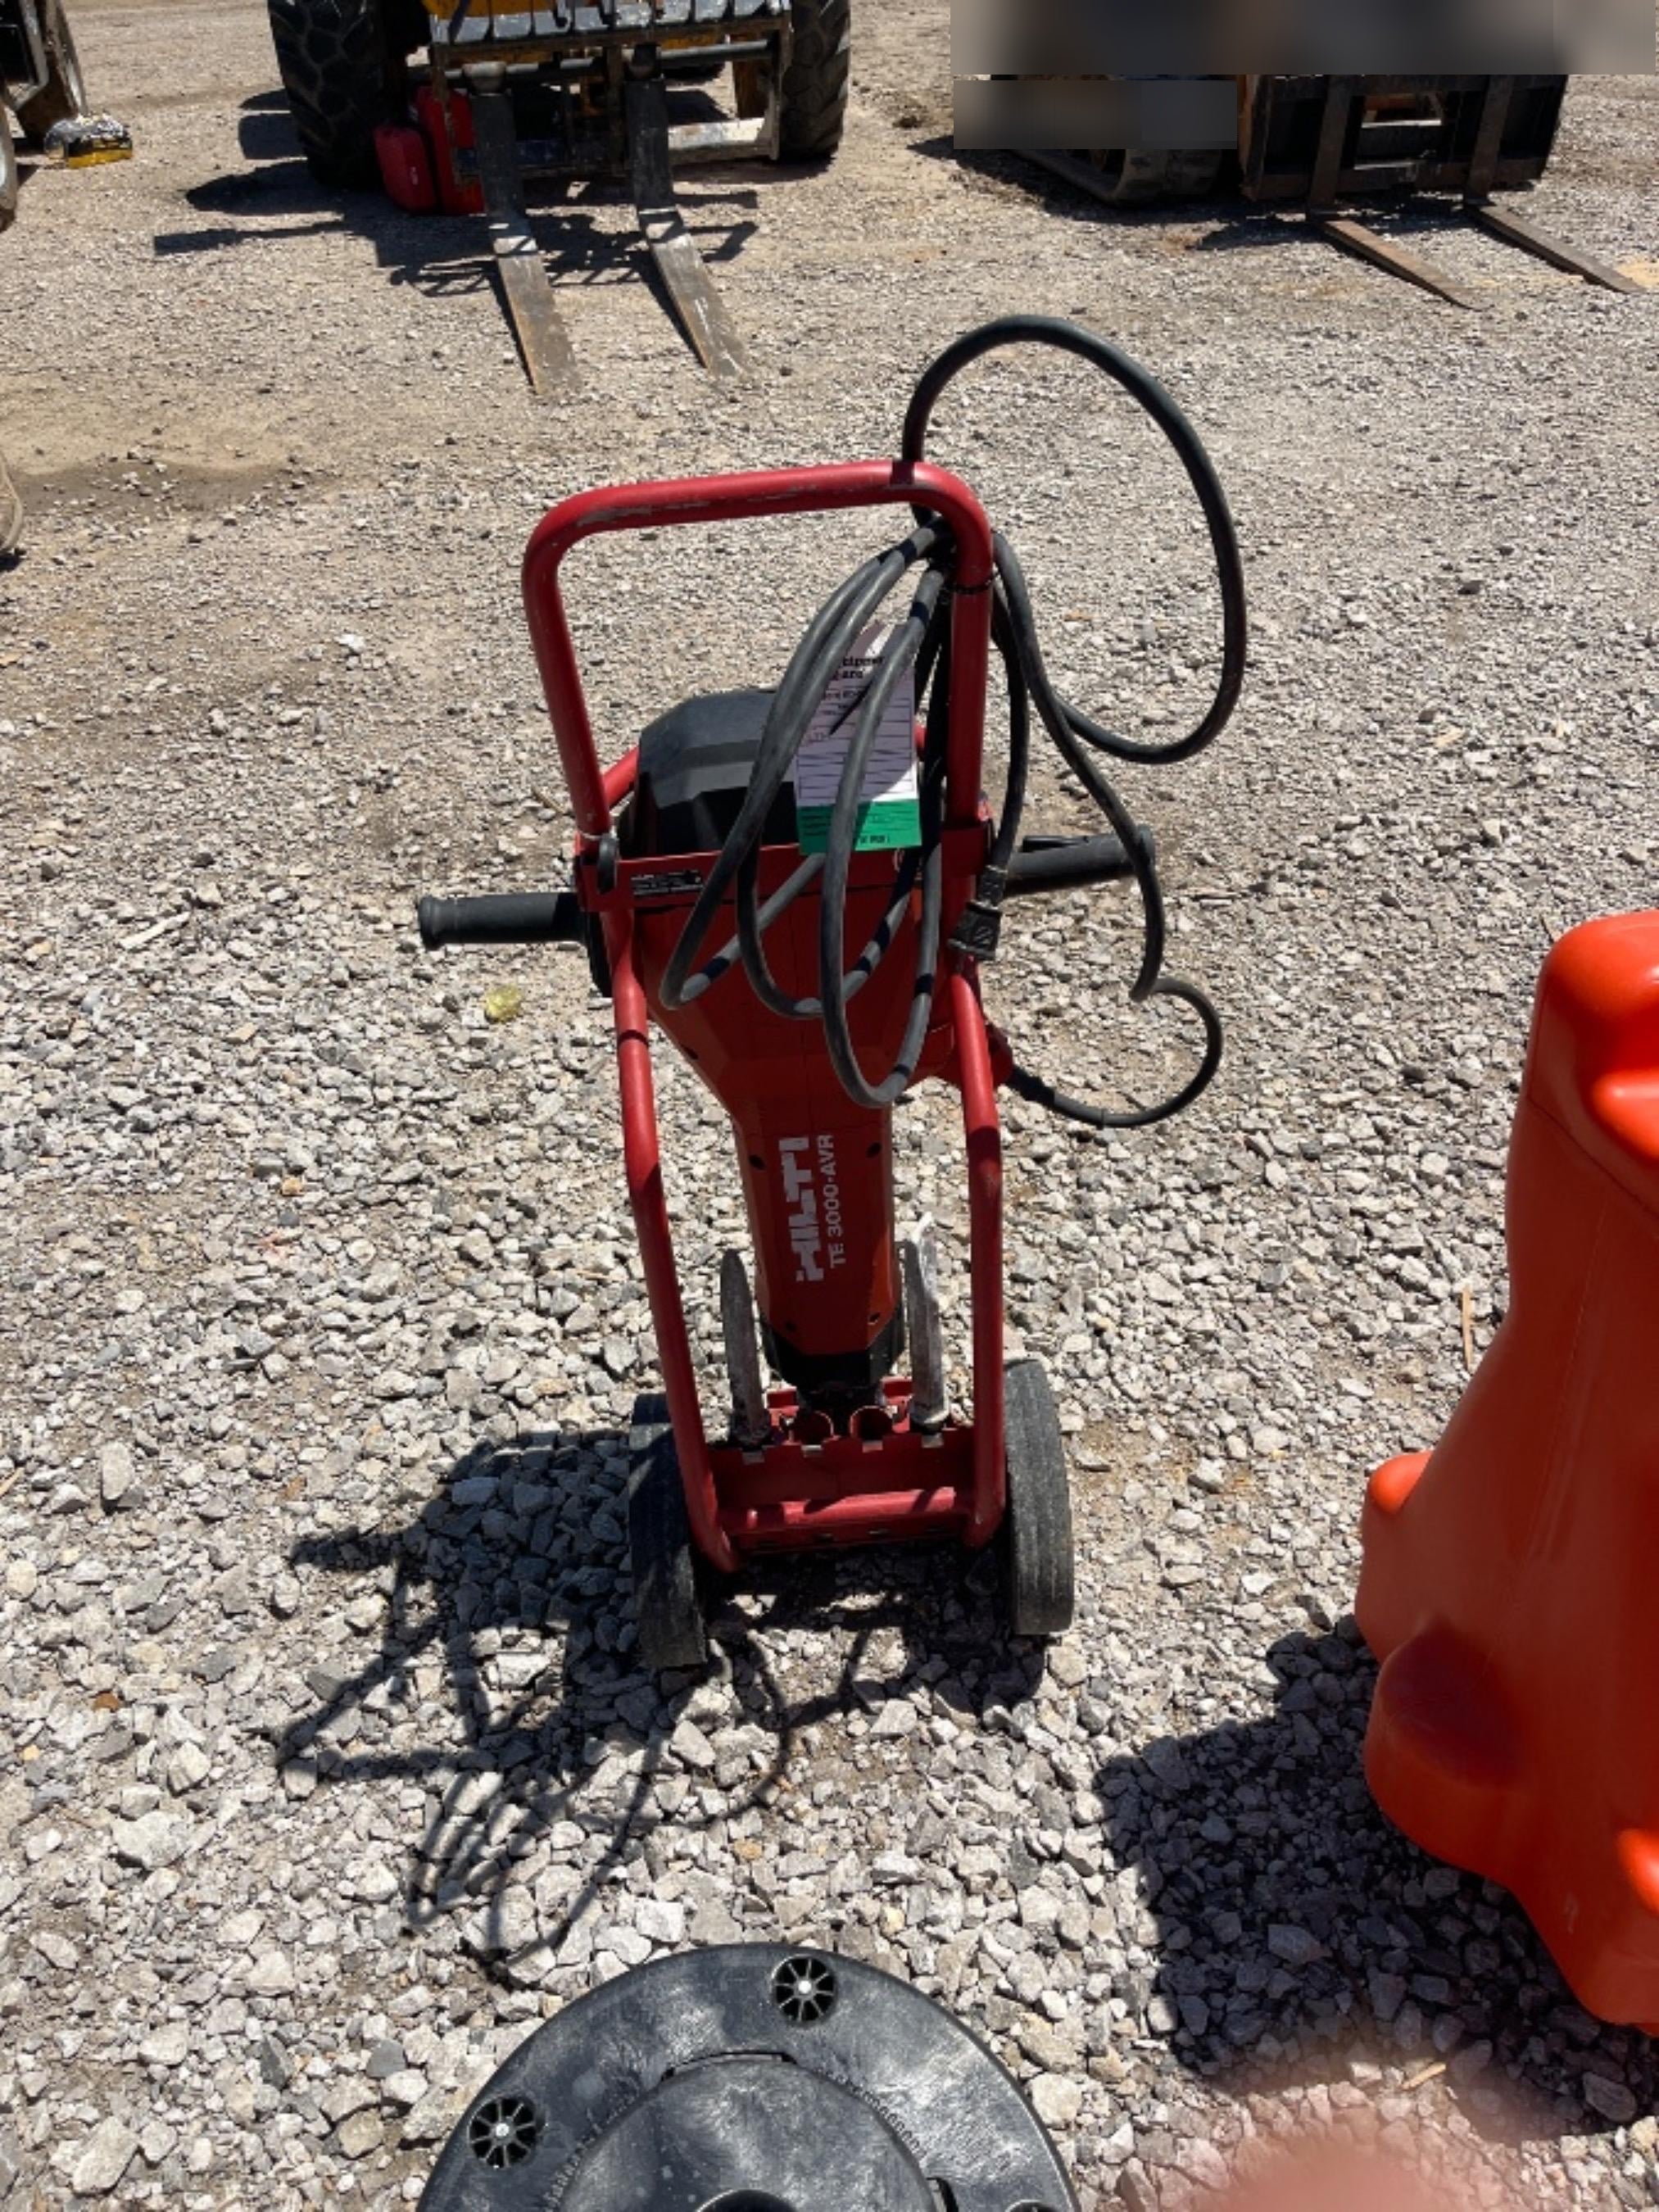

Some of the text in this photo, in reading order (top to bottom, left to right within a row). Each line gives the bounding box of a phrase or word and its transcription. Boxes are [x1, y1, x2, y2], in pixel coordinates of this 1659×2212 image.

[778, 1136, 824, 1282] HILTI
[817, 1134, 846, 1269] TE 3000-AVR
